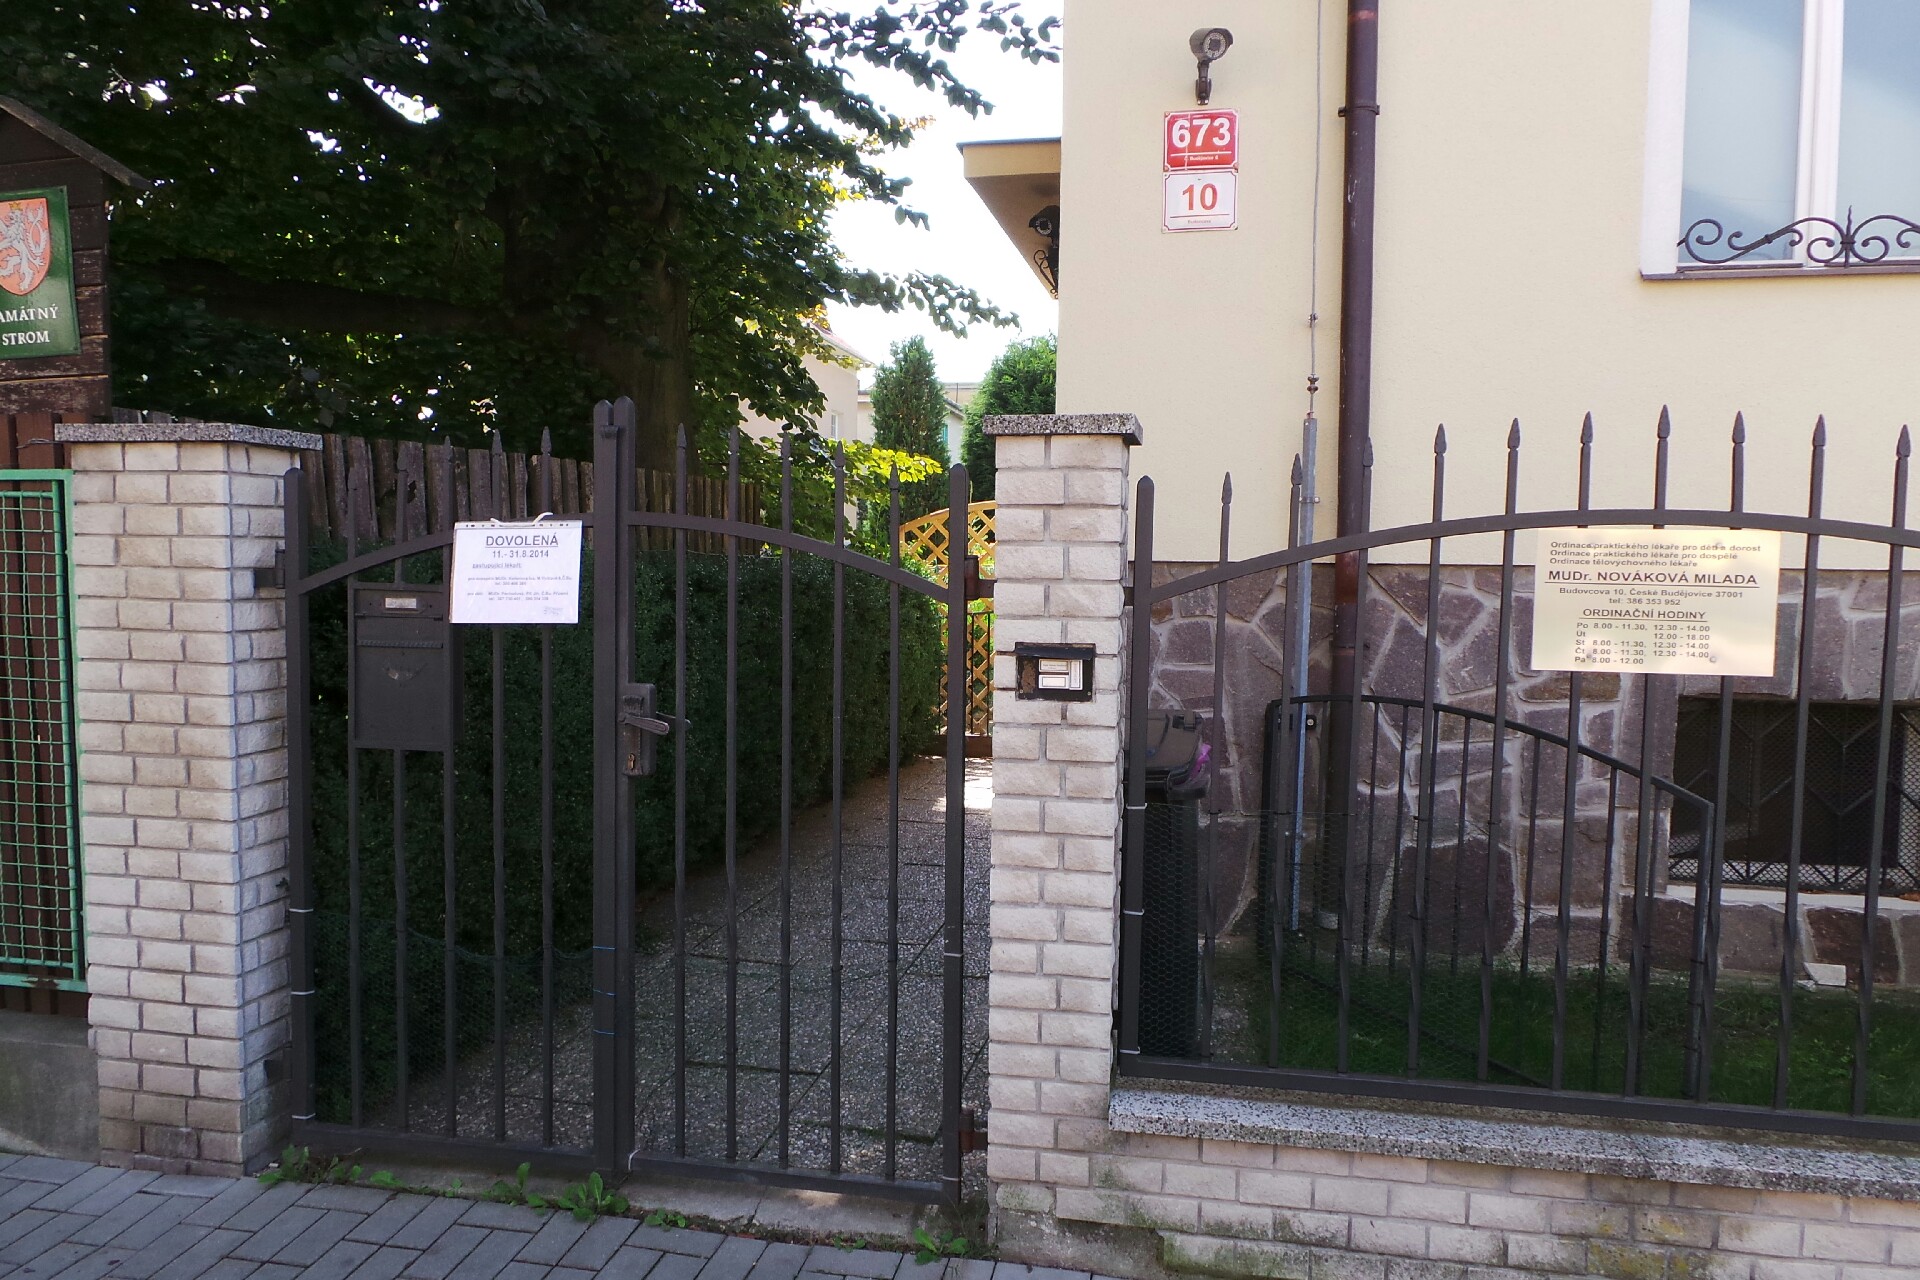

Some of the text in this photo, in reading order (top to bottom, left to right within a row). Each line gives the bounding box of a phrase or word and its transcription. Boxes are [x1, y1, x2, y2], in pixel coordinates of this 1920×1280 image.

[1172, 118, 1231, 148] 673
[1182, 183, 1218, 210] 10
[2, 330, 50, 346] STROM
[486, 532, 559, 546] DOVOLENÁ
[1593, 542, 1649, 550] praktického
[510, 550, 549, 558] 31.8.2014
[1593, 550, 1649, 558] praktického
[1700, 552, 1738, 560] dospělé
[1593, 559, 1667, 567] tělovýchovného
[1548, 570, 1758, 585] MUDr. NOVÁKOVÁ MILADA
[1559, 587, 1610, 595] Budovcova
[1629, 588, 1658, 596] České
[1661, 589, 1713, 598] Budějovice
[1583, 608, 1707, 620] ORDINAČNÍ HODINY
